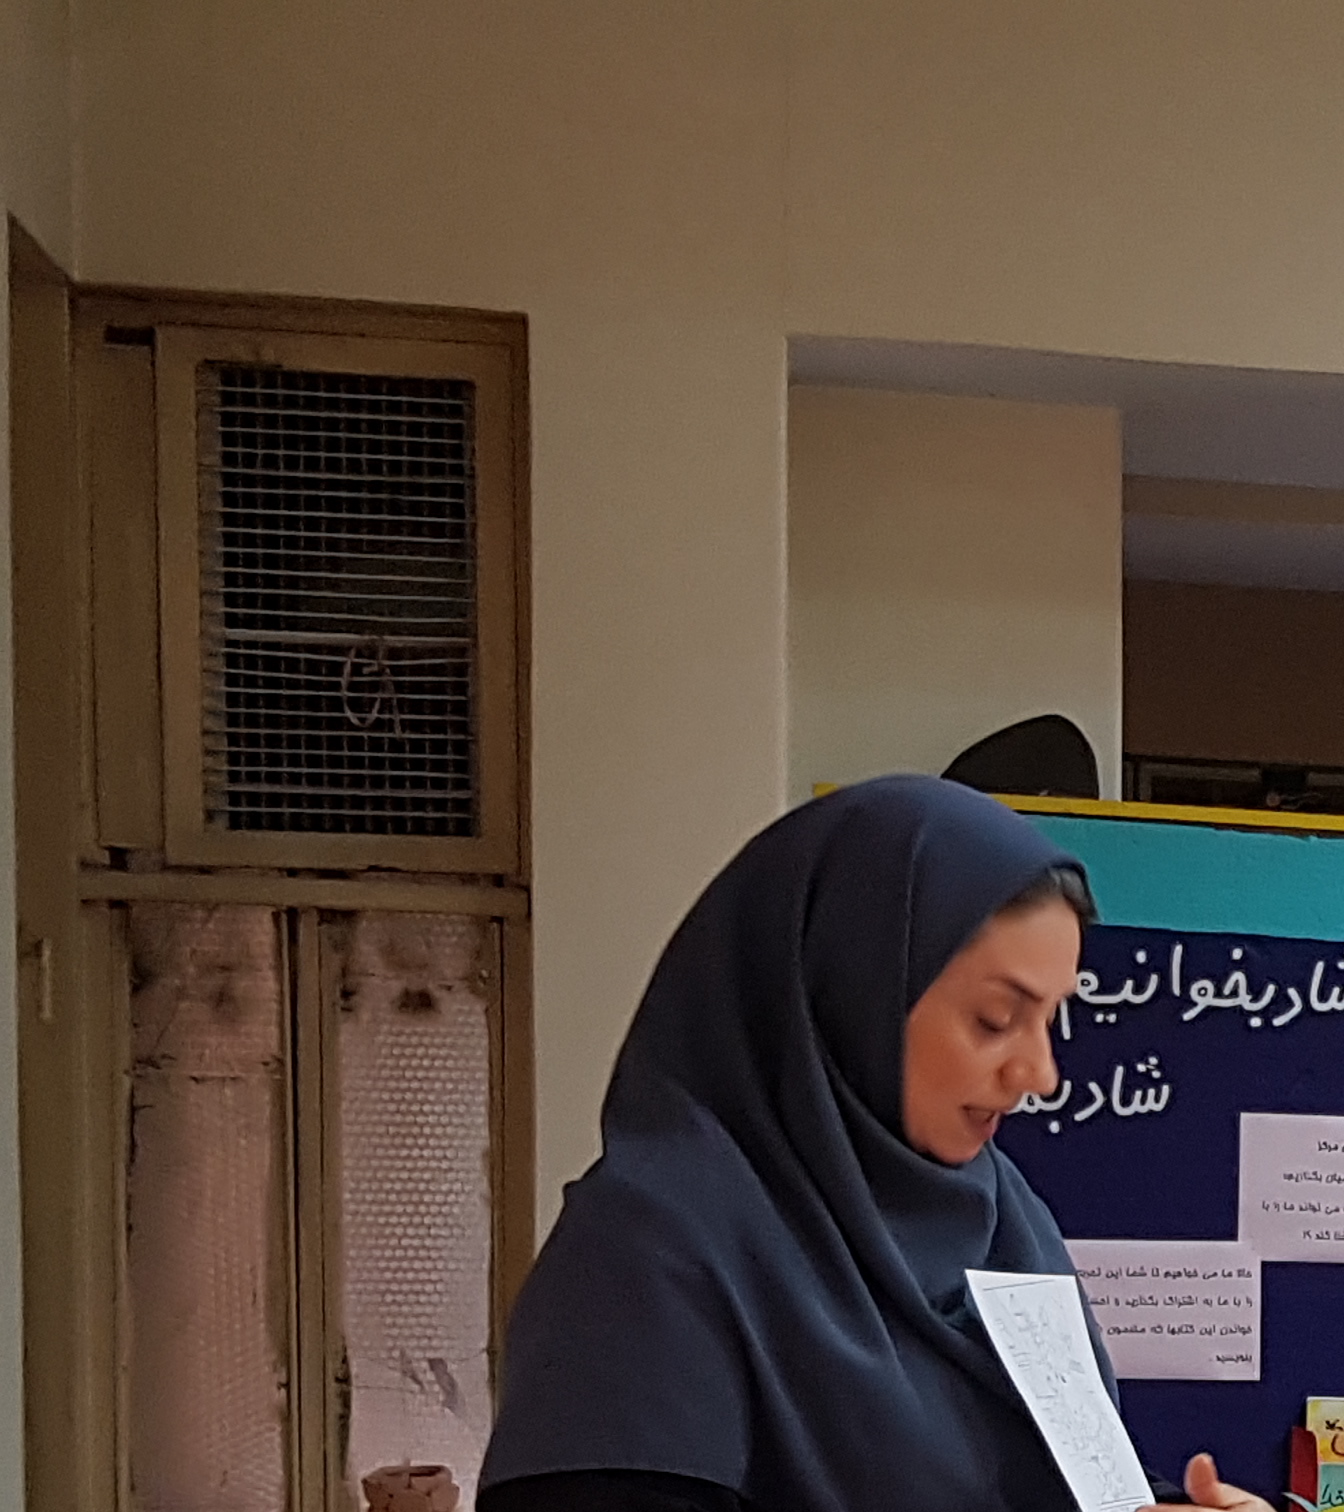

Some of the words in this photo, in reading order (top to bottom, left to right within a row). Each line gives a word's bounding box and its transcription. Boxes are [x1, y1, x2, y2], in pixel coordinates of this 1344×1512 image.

[1073, 1055, 1171, 1122] شاد
[1317, 1140, 1339, 1153] مرکز
[1325, 1206, 1340, 1215] می
[1315, 1230, 1331, 1241] کند
[1105, 1267, 1122, 1280] این
[1126, 1265, 1147, 1277] شما
[1163, 1267, 1198, 1280] خواهیم
[1202, 1271, 1218, 1280] می
[1221, 1268, 1233, 1278] ما
[1125, 1295, 1159, 1308] بگذارید
[1163, 1295, 1198, 1309] اشتراک
[1202, 1297, 1213, 1308] به
[1217, 1295, 1228, 1306] ما
[1151, 1324, 1164, 1335] که
[1167, 1323, 1195, 1337] کتابها
[1200, 1325, 1216, 1336] این
[1219, 1326, 1253, 1336] خواندن
